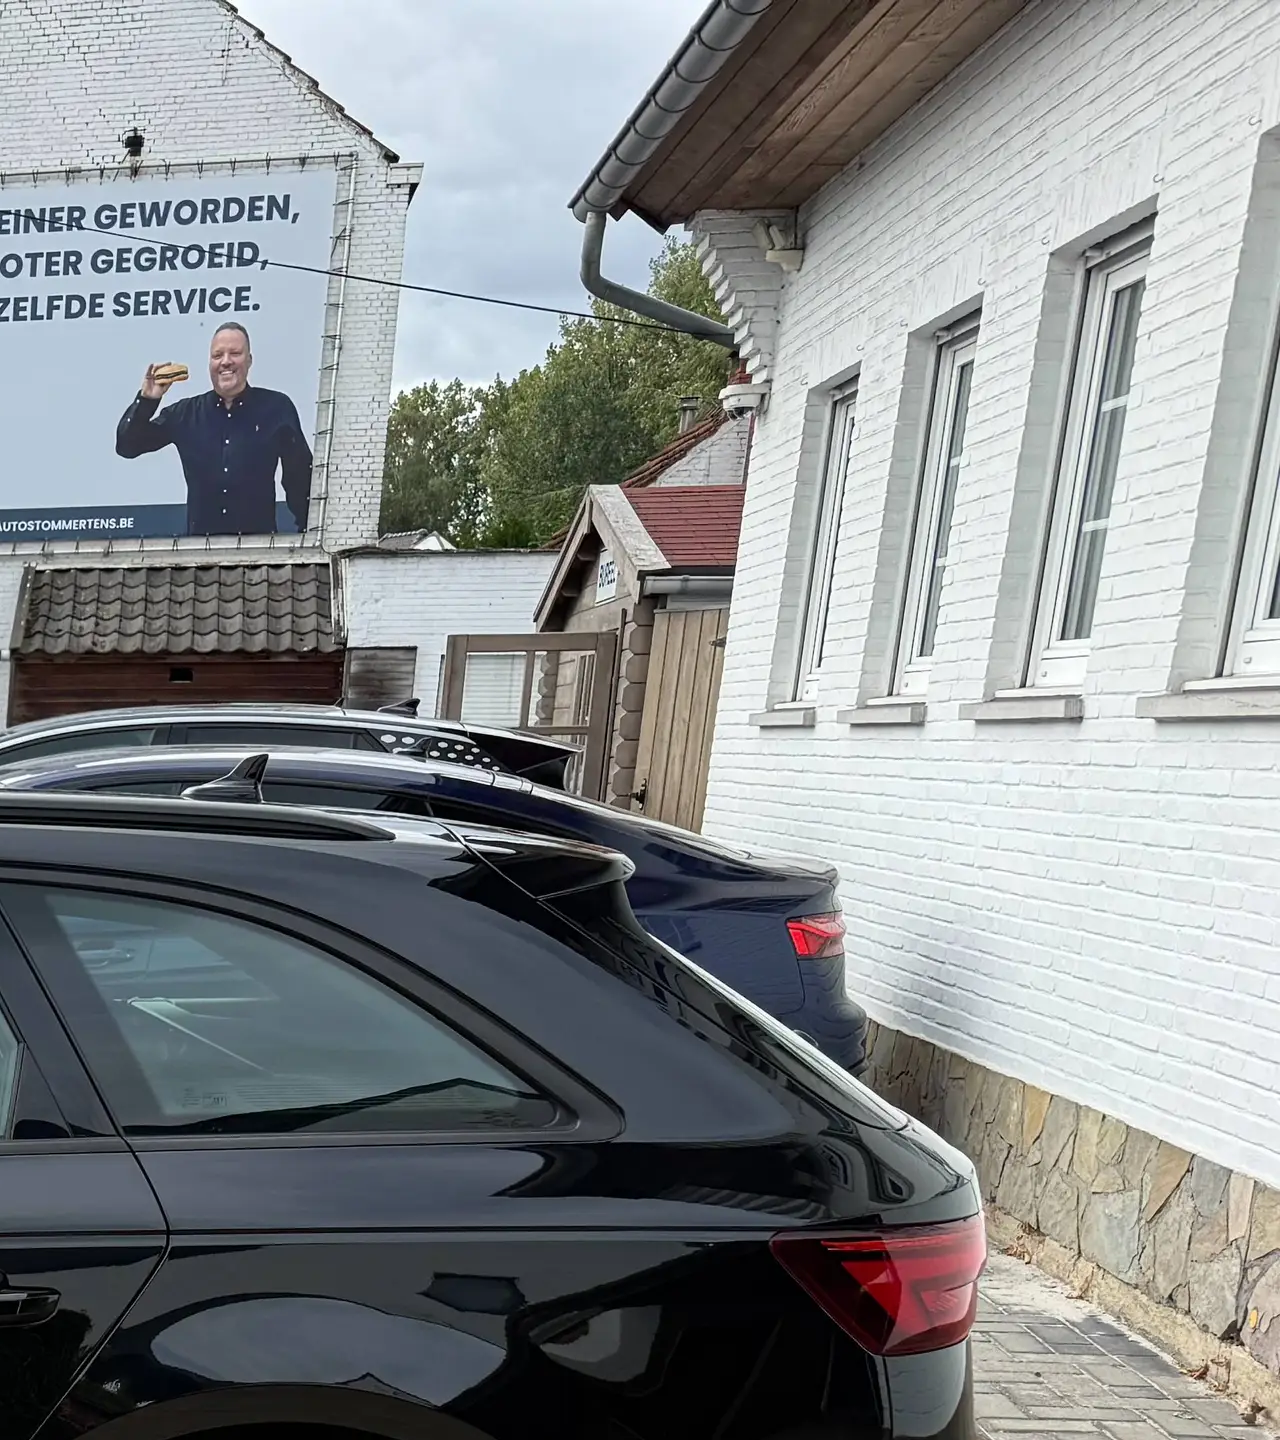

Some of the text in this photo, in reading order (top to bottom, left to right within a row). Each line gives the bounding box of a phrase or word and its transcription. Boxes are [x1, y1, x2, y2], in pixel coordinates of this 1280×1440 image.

[93, 193, 300, 230] GEWORDEN,
[90, 241, 268, 274] GEGROEID,
[112, 286, 261, 317] SERVICE.
